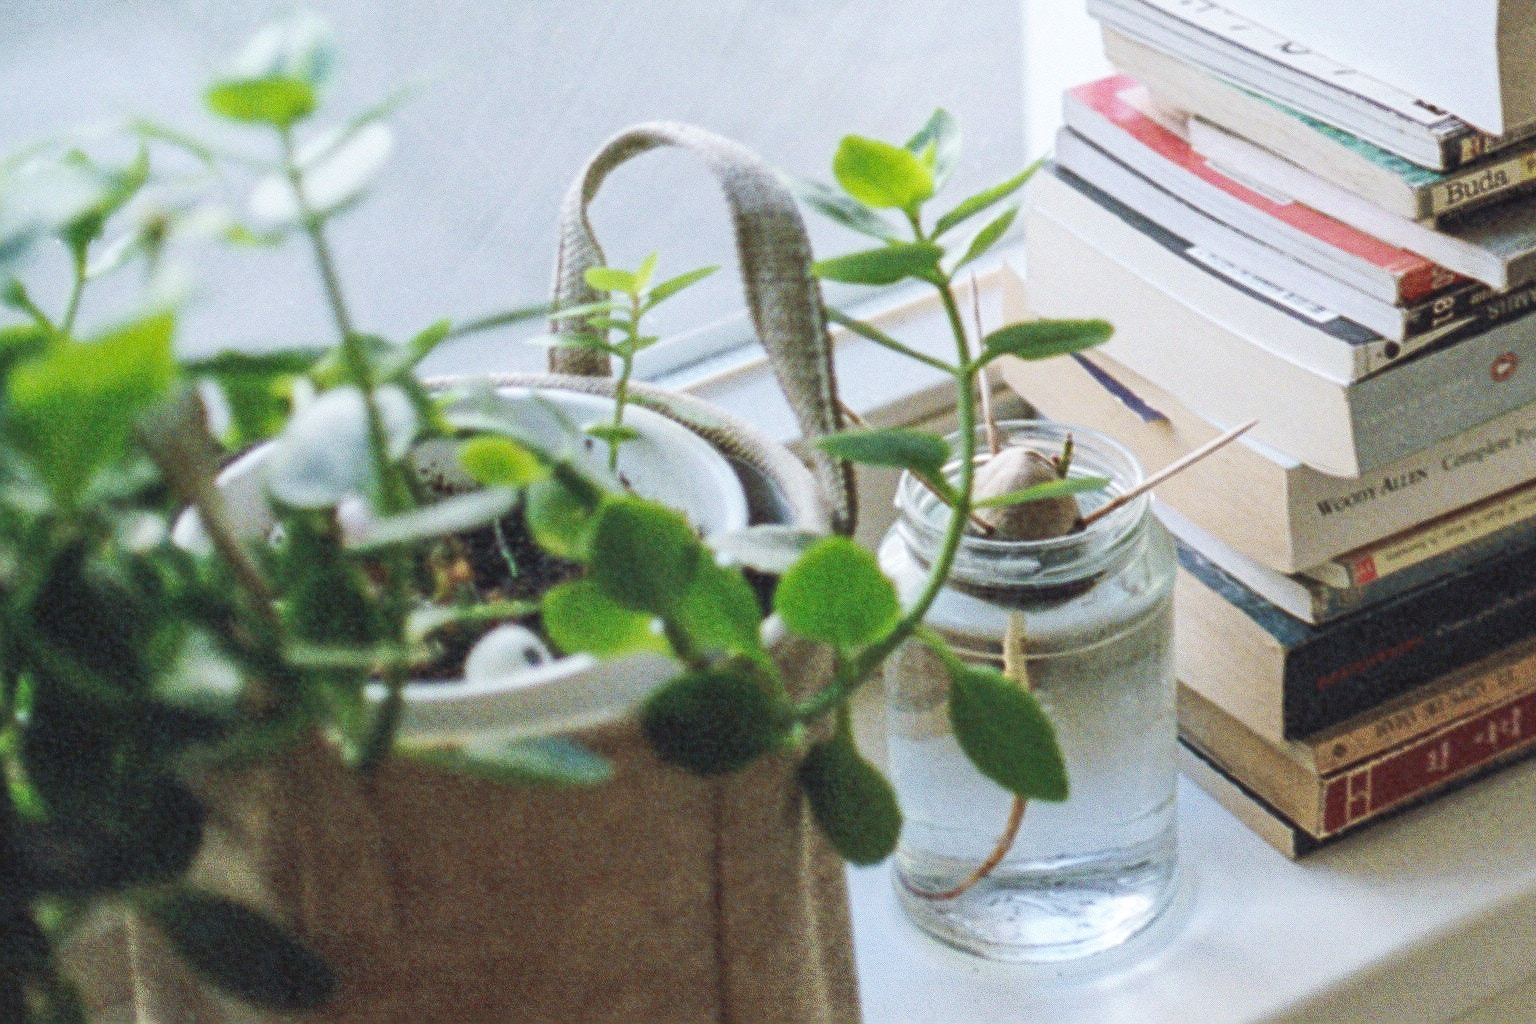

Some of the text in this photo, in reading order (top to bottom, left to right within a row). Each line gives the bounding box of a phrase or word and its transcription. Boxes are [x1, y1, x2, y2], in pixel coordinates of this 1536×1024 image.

[1446, 169, 1508, 205] Buda
[1317, 488, 1377, 517] WOODY
[1381, 467, 1428, 494] ALLEN
